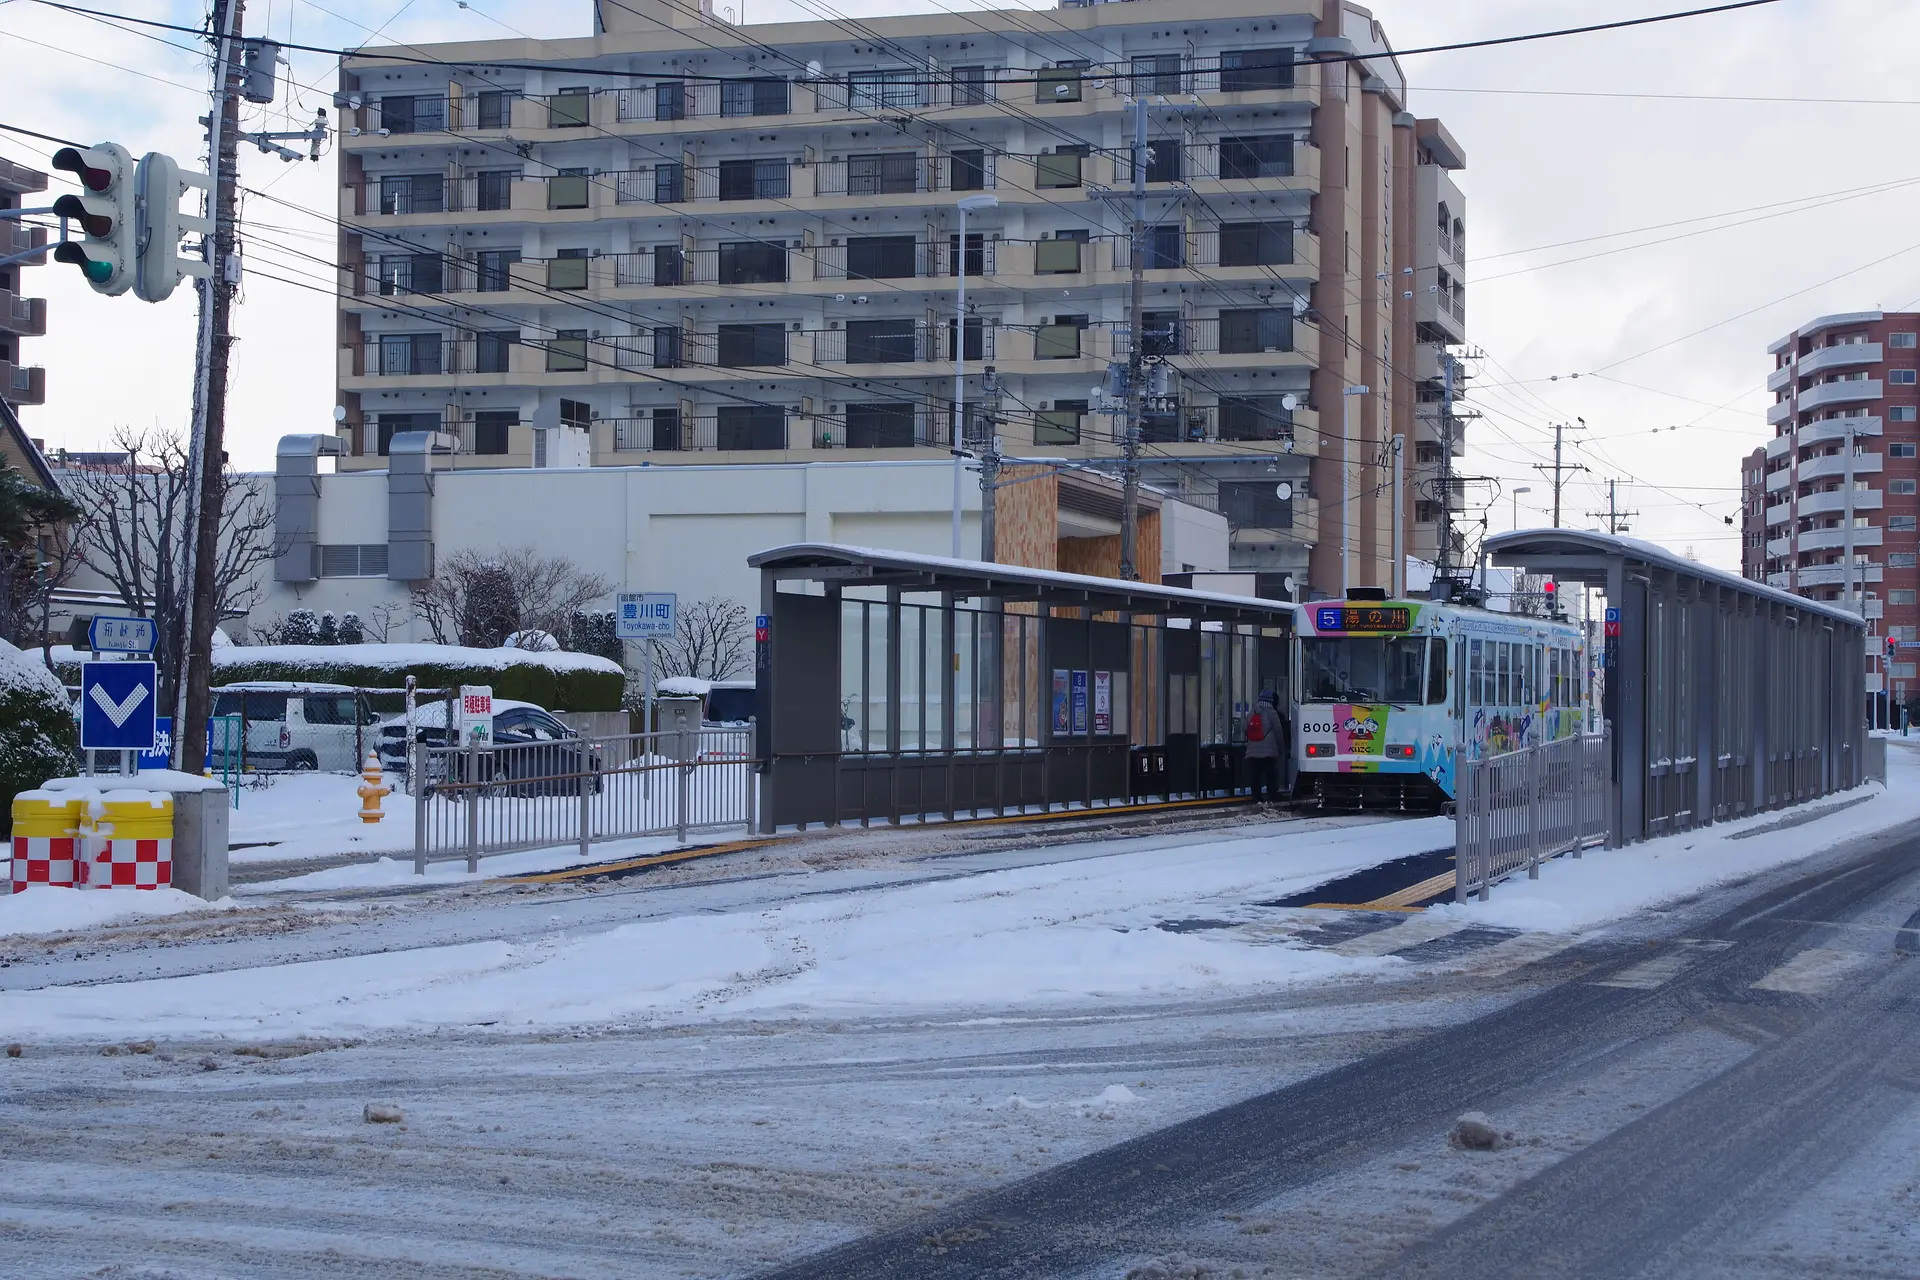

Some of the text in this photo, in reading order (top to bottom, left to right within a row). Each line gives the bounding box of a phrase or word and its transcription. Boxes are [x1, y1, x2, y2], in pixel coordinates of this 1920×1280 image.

[623, 603, 671, 619] 豊川町
[1607, 610, 1617, 621] D
[757, 617, 766, 628] D
[1323, 611, 1336, 627] 5
[1345, 609, 1406, 625] 湯の川
[622, 621, 670, 631] Toyokawa-cho
[1608, 624, 1617, 635] Y
[758, 630, 766, 640] Y
[128, 640, 137, 649] St.
[464, 695, 491, 714] 月極駐車場
[1303, 723, 1340, 733] 8002
